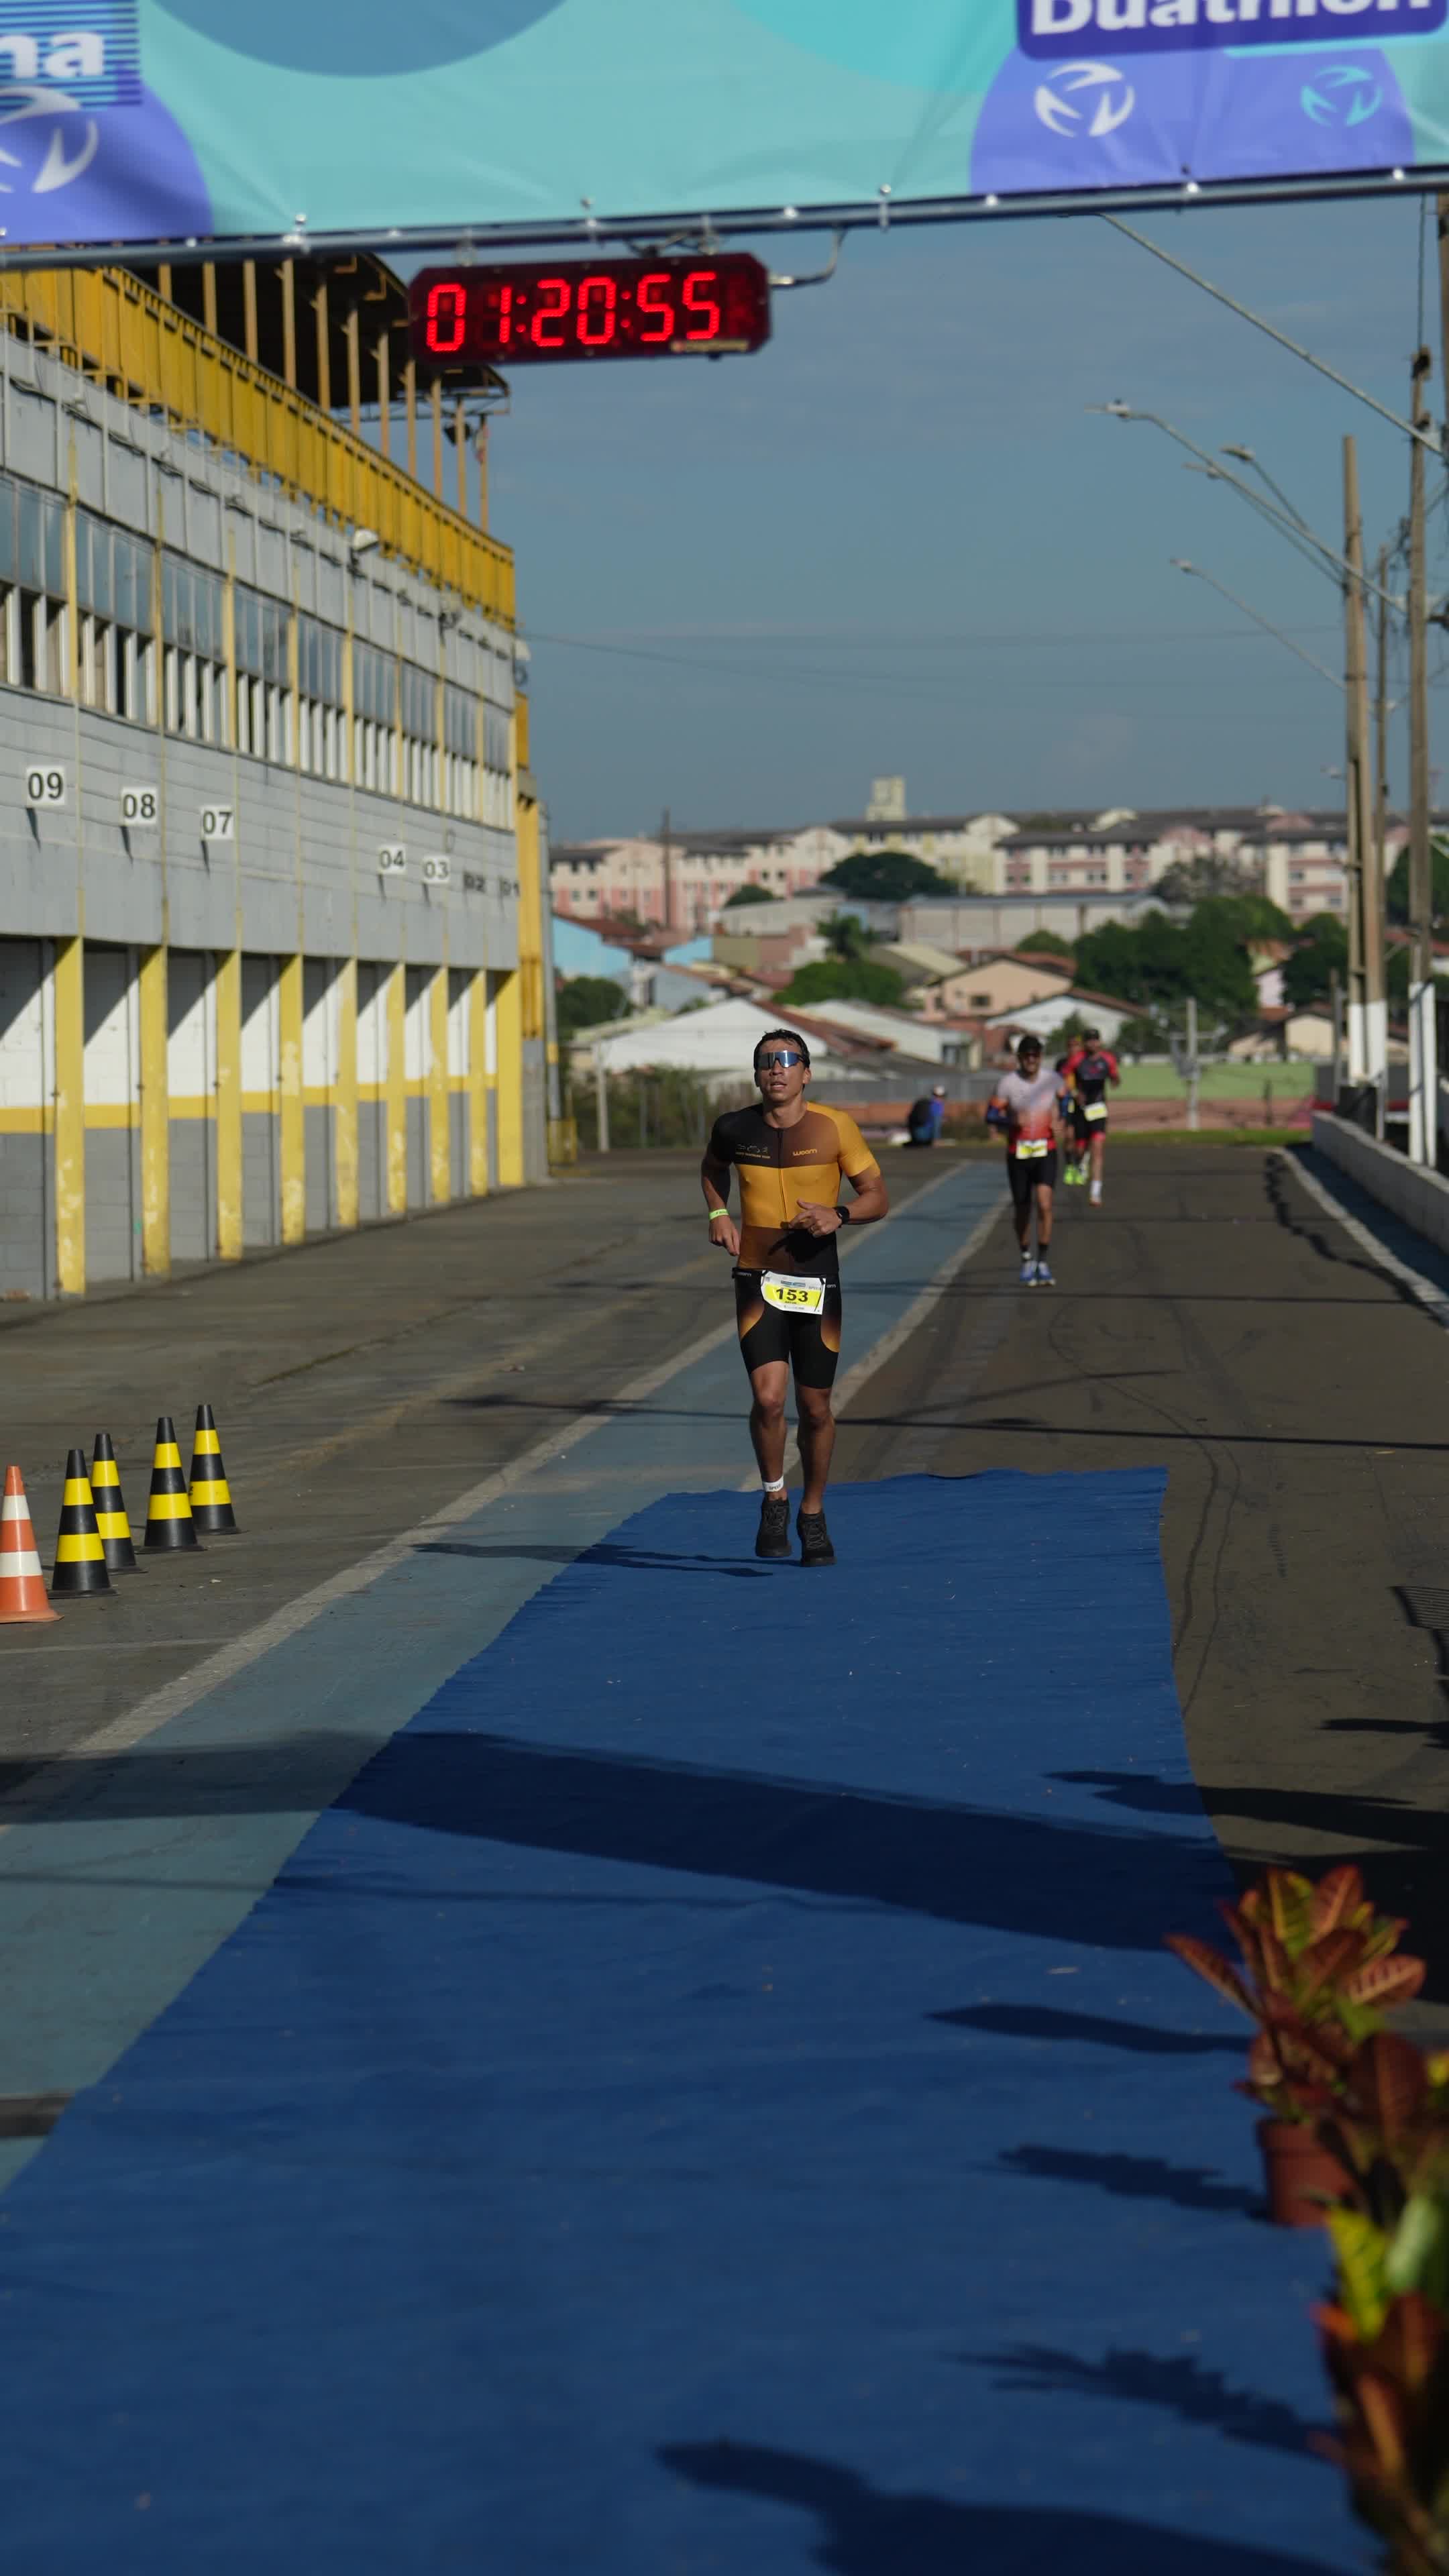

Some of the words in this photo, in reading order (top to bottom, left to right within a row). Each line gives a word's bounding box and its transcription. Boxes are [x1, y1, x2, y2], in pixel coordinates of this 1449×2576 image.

[1031, 0, 1431, 34] Duat
[427, 271, 720, 352] 01:20:55
[28, 771, 64, 800] 09
[123, 794, 156, 818] 08
[203, 811, 233, 834] 07
[380, 850, 405, 869] 04
[423, 861, 449, 879] 03
[775, 1287, 808, 1303] 153
